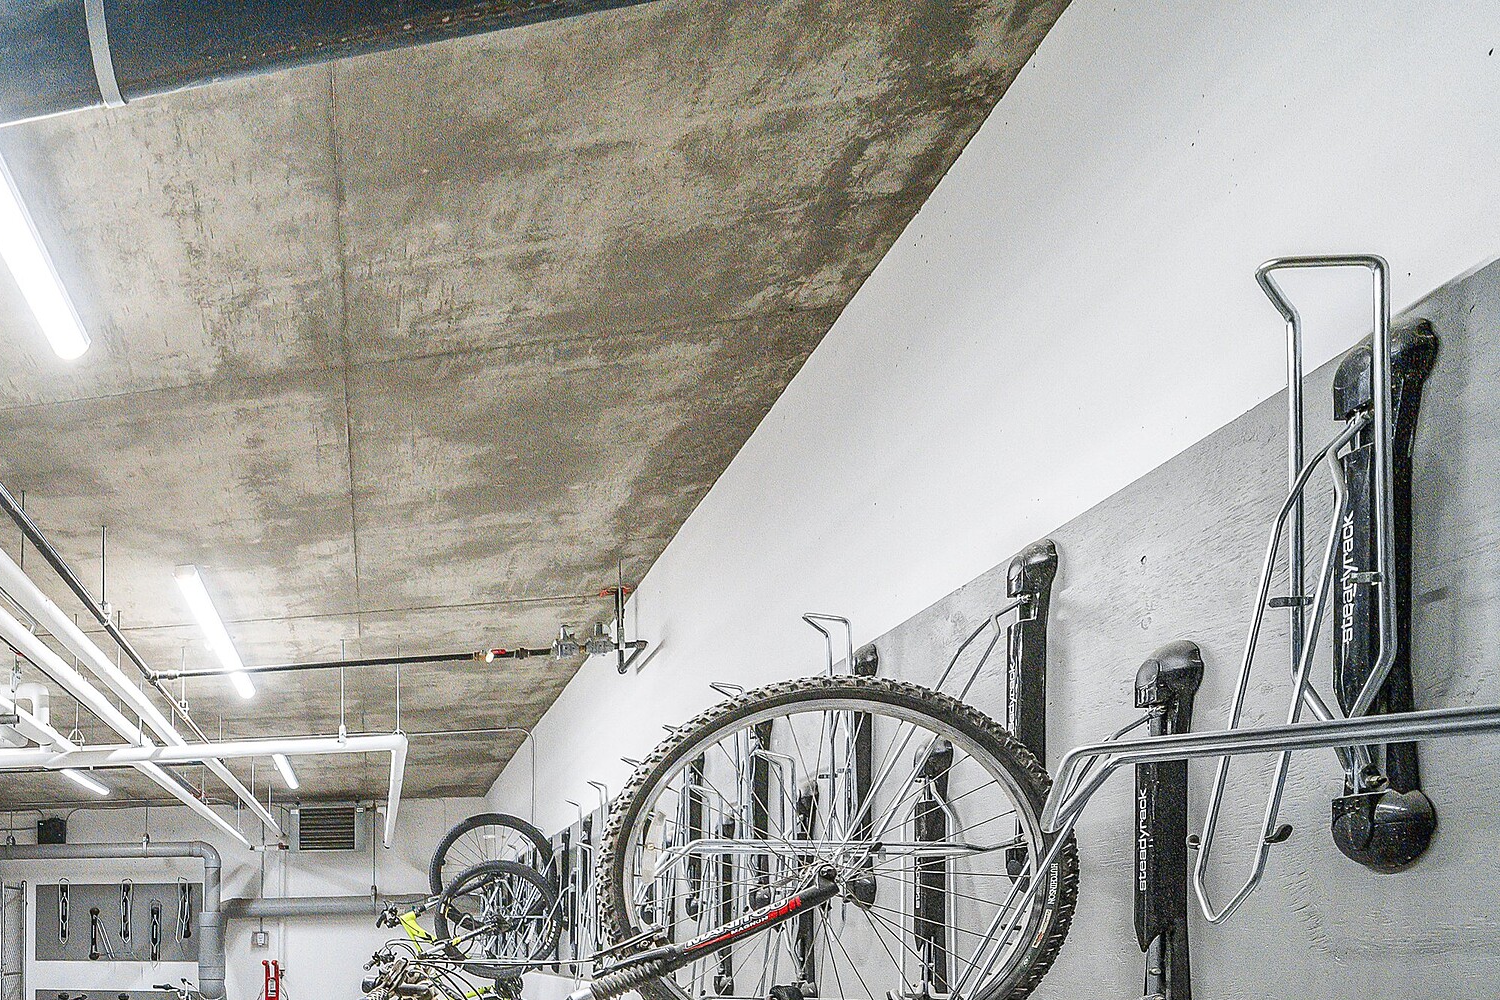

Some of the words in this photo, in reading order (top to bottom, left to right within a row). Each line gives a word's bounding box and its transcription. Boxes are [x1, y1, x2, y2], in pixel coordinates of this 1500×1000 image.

[1340, 510, 1359, 643] steadyrack
[1008, 662, 1018, 737] eadyrack
[1137, 787, 1150, 891] steadyrack
